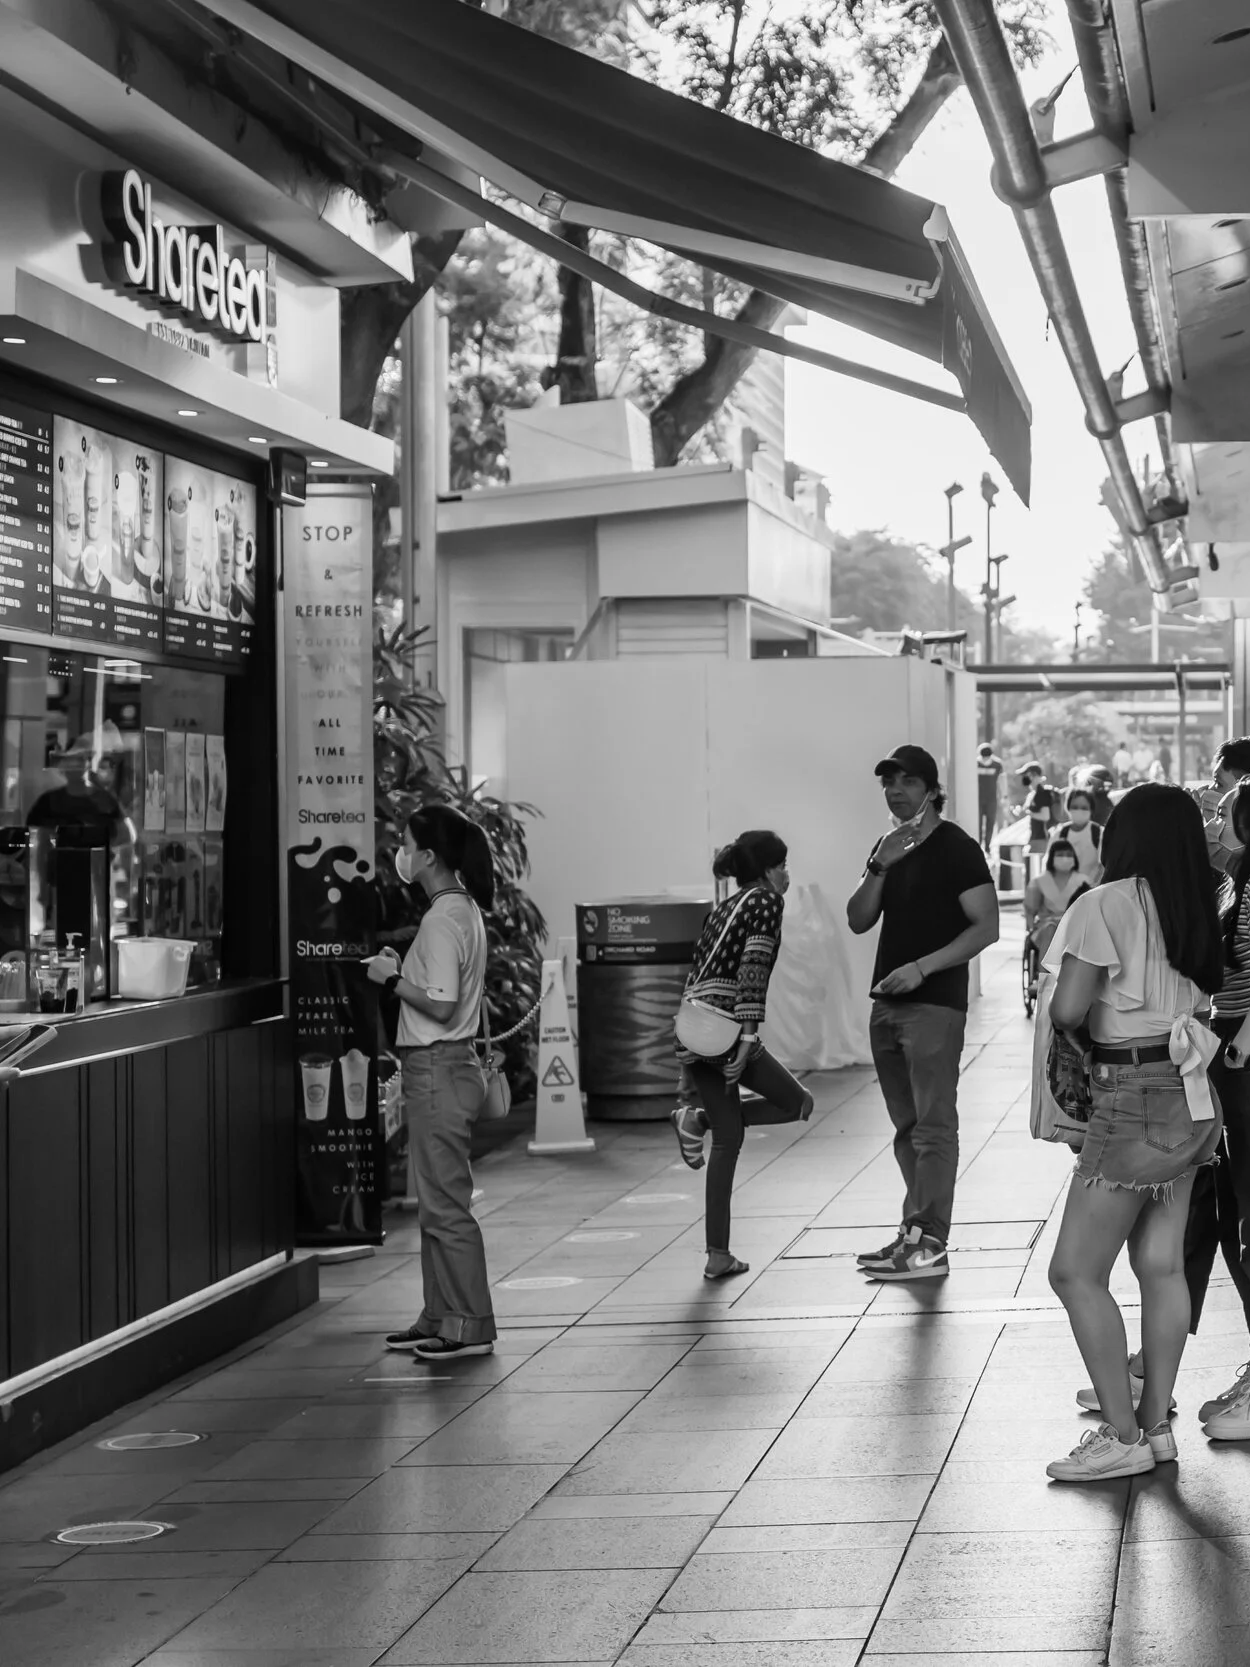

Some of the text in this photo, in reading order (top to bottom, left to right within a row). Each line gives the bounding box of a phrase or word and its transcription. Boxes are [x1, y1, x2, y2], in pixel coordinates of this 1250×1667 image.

[122, 168, 267, 344] Sharetea
[302, 525, 353, 541] STOP
[324, 568, 333, 580] &
[295, 604, 363, 617] REFRESH
[318, 718, 341, 728] ALL
[315, 746, 345, 756] TIME
[297, 775, 364, 785] FAVORITE
[298, 808, 366, 824] Sharetea
[606, 907, 621, 916] NO
[607, 915, 651, 925] SMOKING
[607, 924, 632, 933] ZONE
[296, 939, 369, 957] Sharetea
[297, 996, 350, 1005] CLASSIC
[298, 1011, 335, 1020] PEARL
[298, 1026, 355, 1036] MILK TEA
[327, 1128, 373, 1137] MANGO
[310, 1143, 373, 1153] SMOOTHIE
[346, 1161, 375, 1169] WITH
[355, 1172, 374, 1182] ICE
[332, 1185, 375, 1195] CREAM
